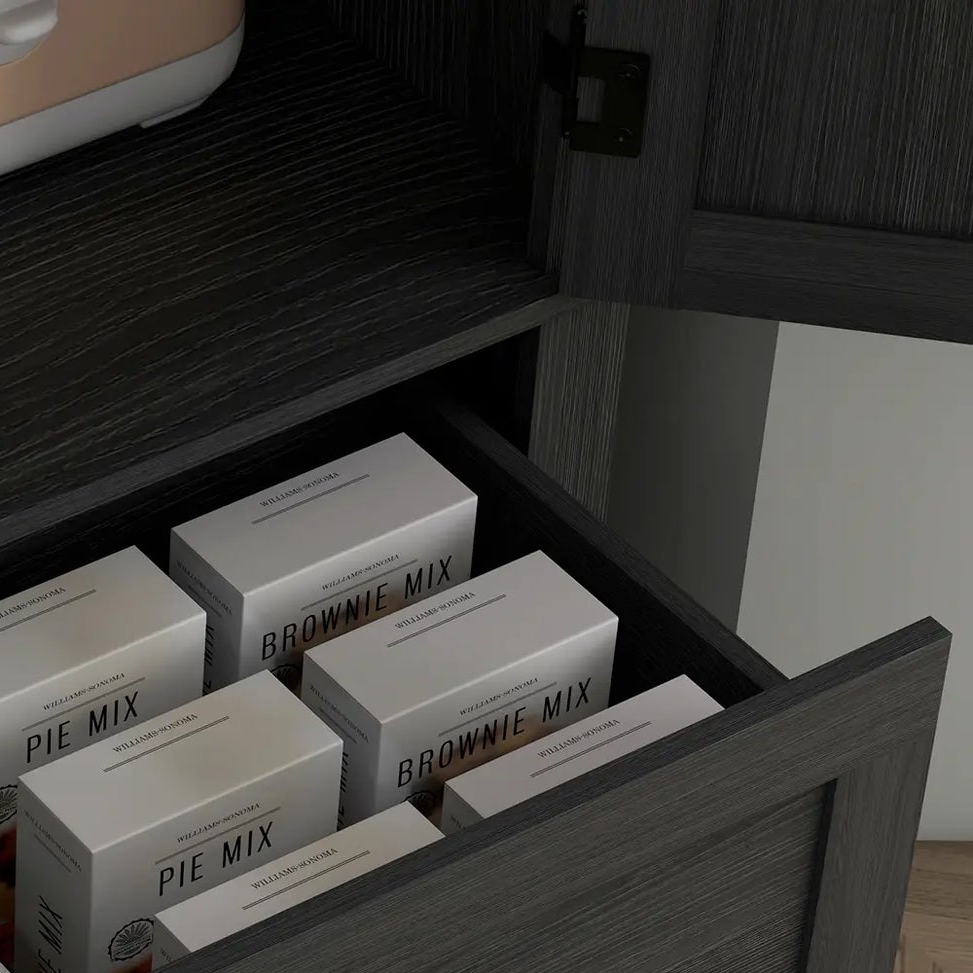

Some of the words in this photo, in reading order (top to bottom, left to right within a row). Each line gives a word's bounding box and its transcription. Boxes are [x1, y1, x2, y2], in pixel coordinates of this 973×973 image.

[261, 582, 388, 661] BROWNIE
[404, 555, 452, 600] MIX
[26, 720, 71, 764] PIE
[89, 691, 139, 737] MIX
[397, 706, 527, 788] BROWNIE
[541, 677, 592, 723] MIX
[159, 852, 204, 897] PIE
[222, 821, 273, 868] MIX
[38, 895, 63, 955] MIX
